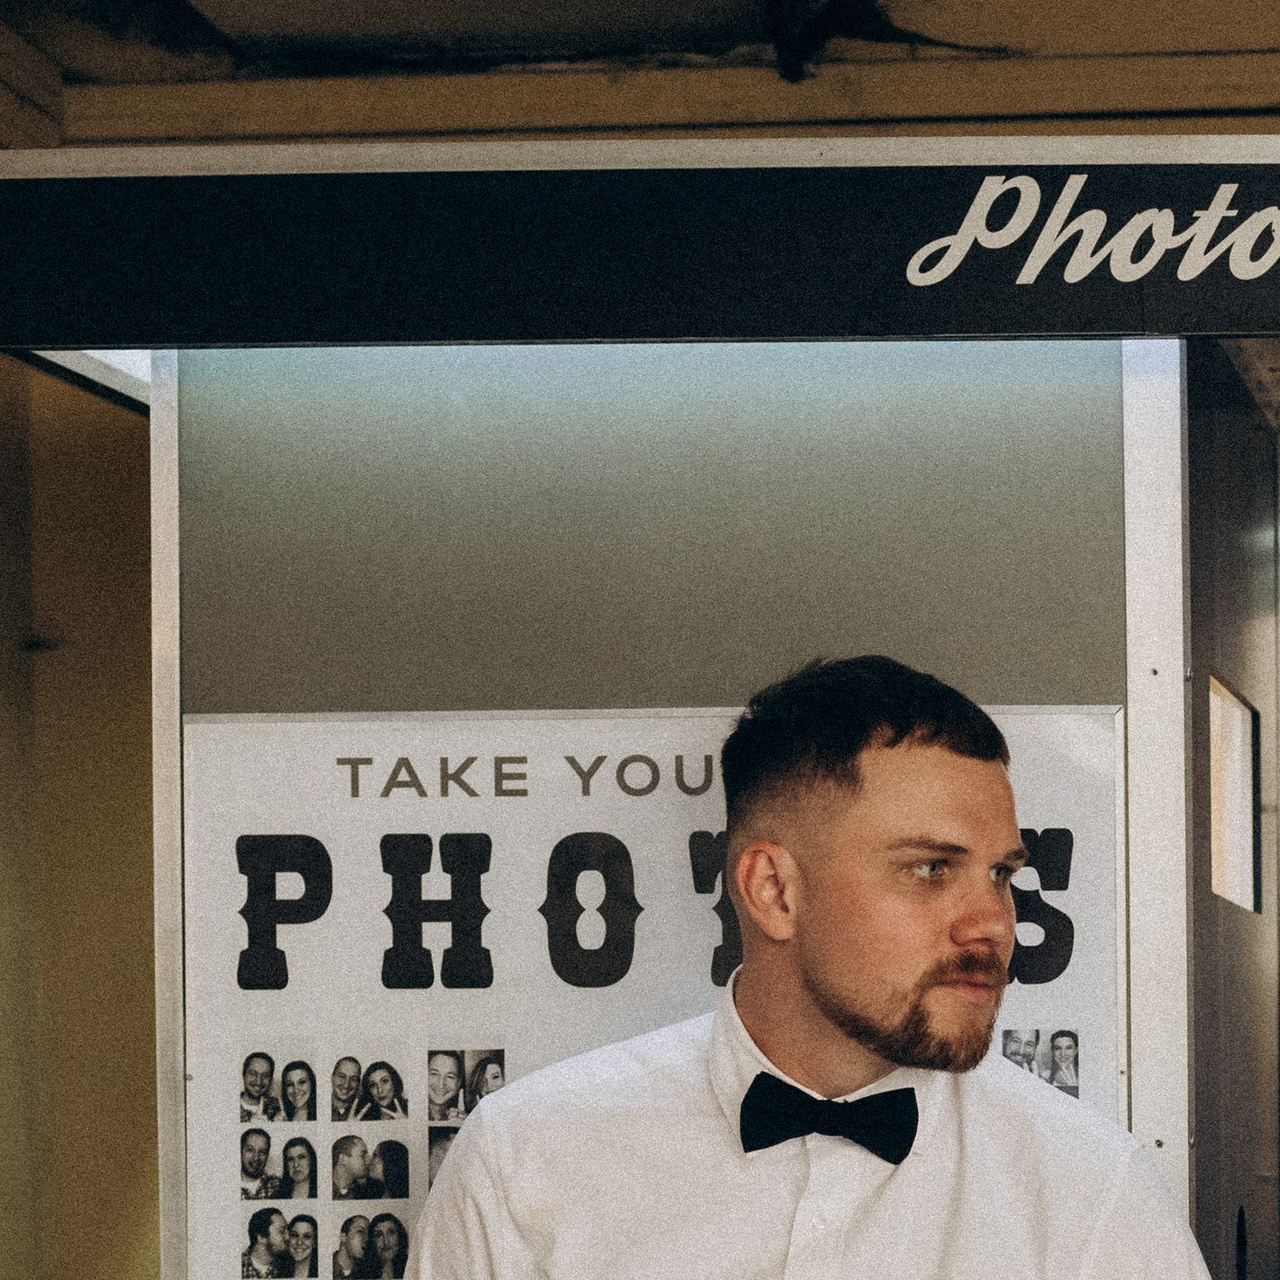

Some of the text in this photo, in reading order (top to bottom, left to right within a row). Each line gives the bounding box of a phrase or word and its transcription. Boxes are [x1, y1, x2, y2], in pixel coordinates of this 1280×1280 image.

[337, 754, 714, 798] TAKE YOU
[235, 828, 1075, 990] PHOS
